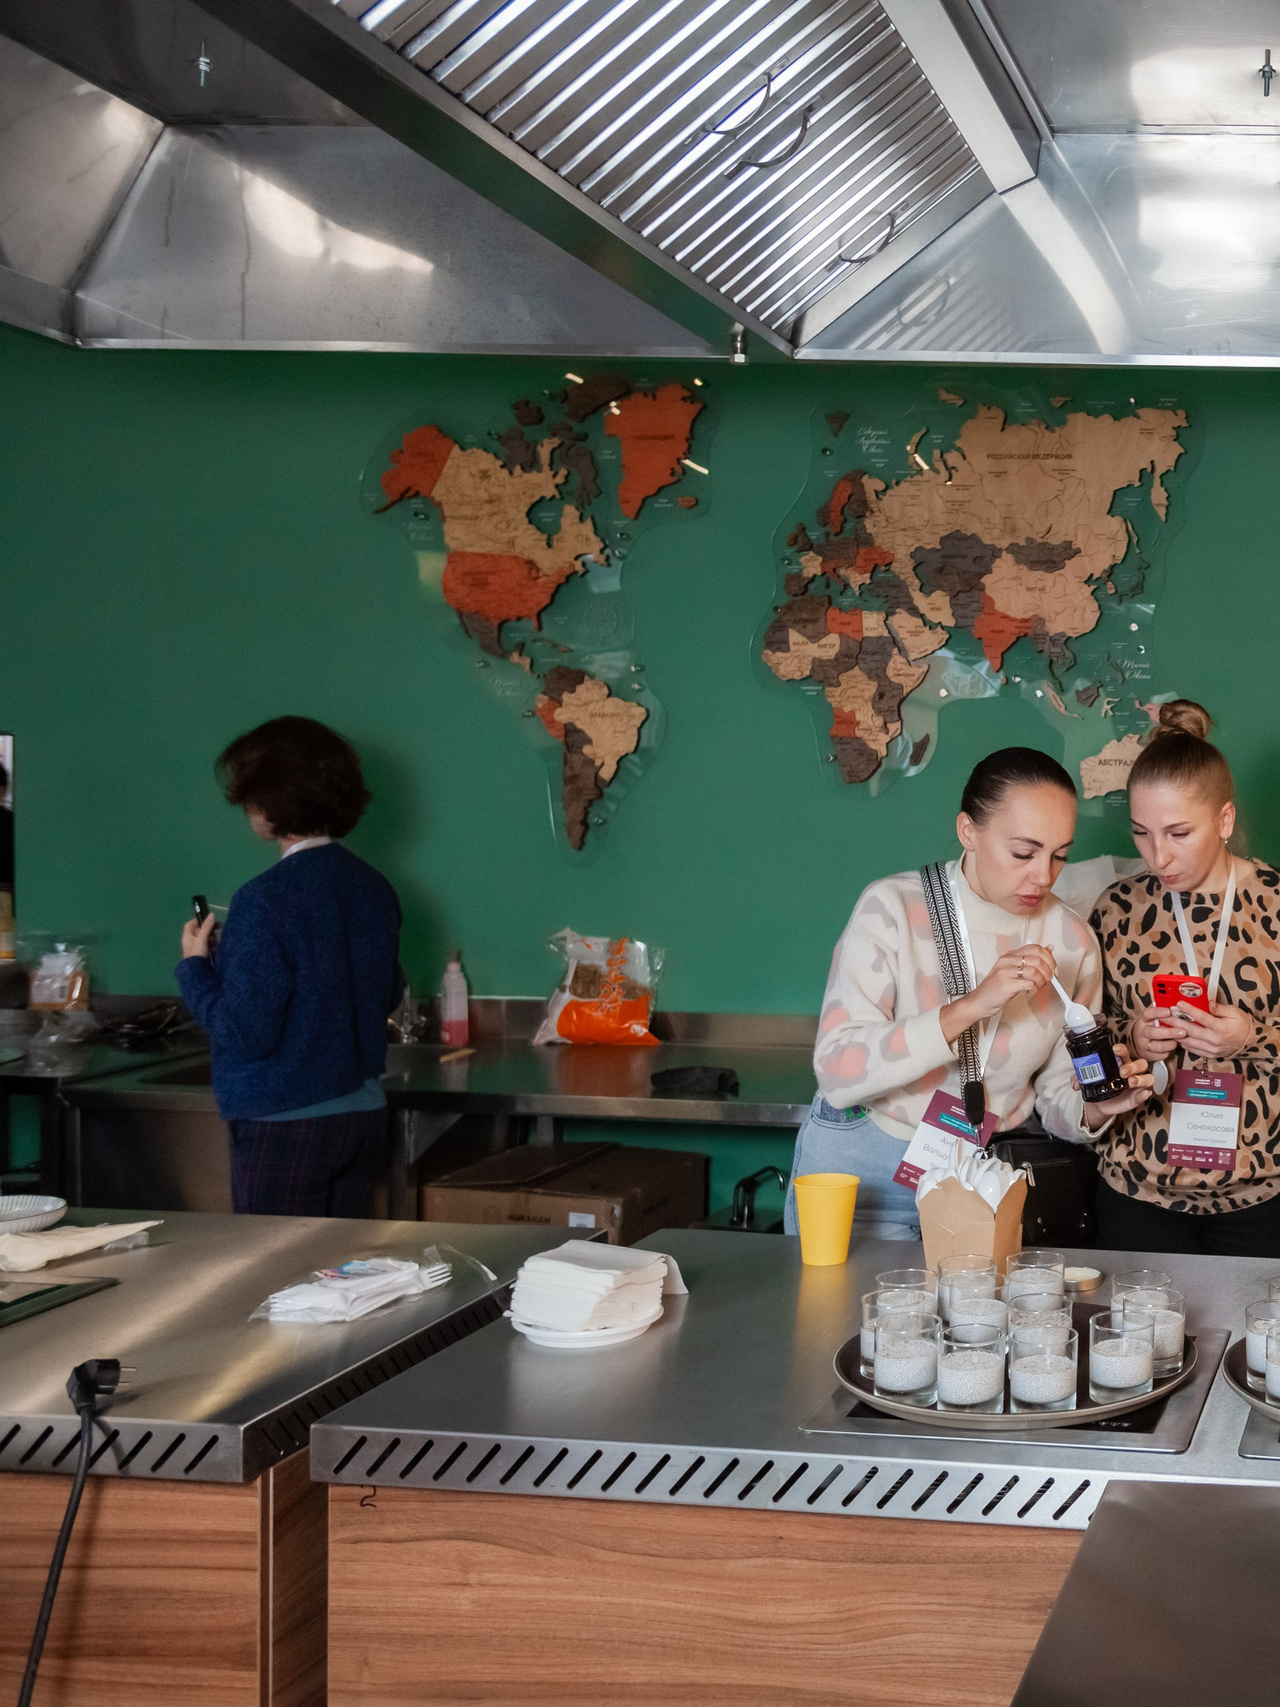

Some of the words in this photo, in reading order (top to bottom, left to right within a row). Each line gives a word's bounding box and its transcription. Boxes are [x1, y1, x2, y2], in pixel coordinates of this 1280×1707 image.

[1098, 758, 1133, 767] АВСТРАЛ
[1200, 1111, 1224, 1119] Юлия
[1187, 1122, 1235, 1133] Сенокосова
[923, 1143, 950, 1161] Волшу
